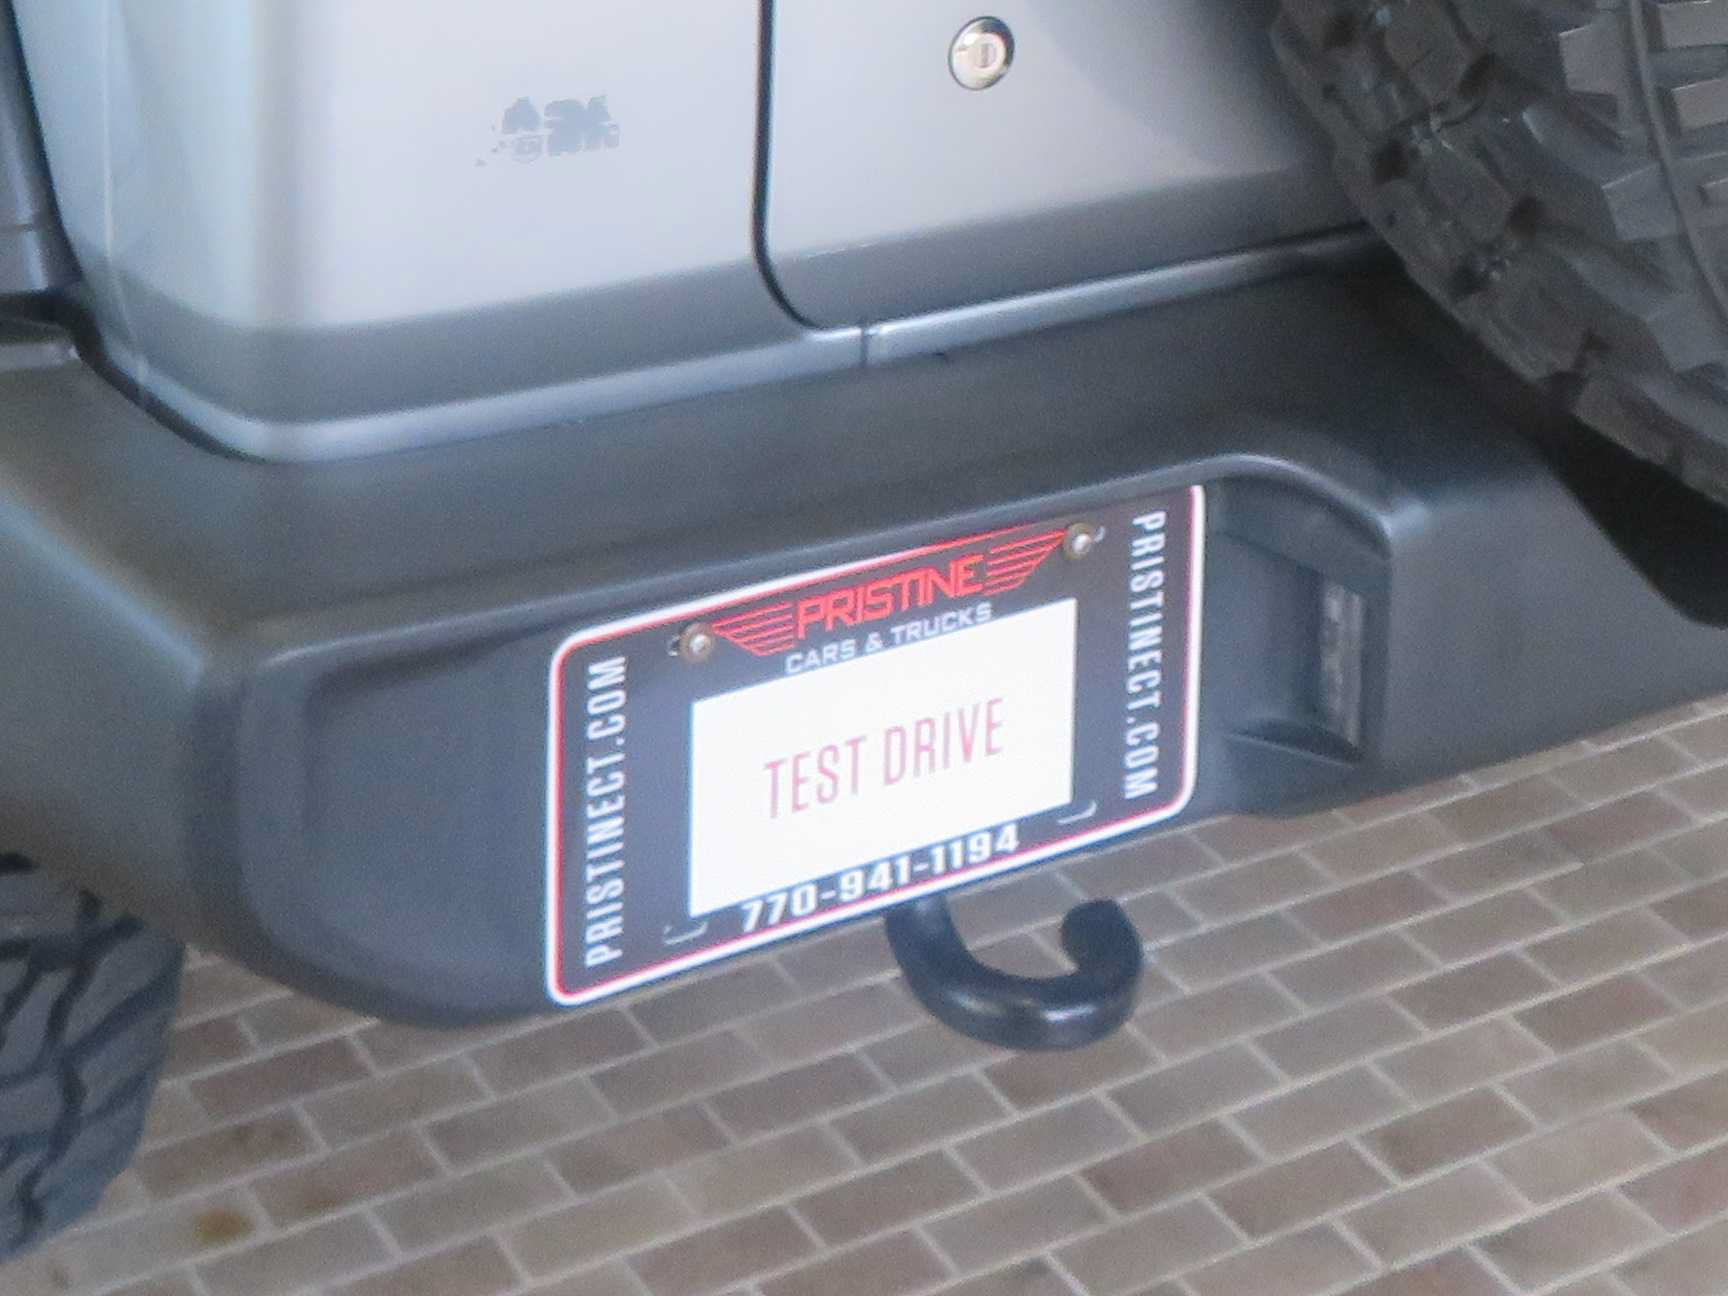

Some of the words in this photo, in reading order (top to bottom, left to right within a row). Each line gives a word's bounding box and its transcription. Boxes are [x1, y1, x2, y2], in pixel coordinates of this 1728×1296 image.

[785, 636, 856, 675] CARS
[865, 629, 884, 652] &
[889, 602, 993, 643] TRUCKS
[794, 554, 985, 640] PRISTINE
[1124, 511, 1166, 800] PRISTINECT.COM
[585, 655, 626, 968] PRISTINECT.COM
[764, 736, 869, 820] TEST
[883, 697, 1005, 789] DRIVE
[739, 824, 1021, 932] 770-941-1194
